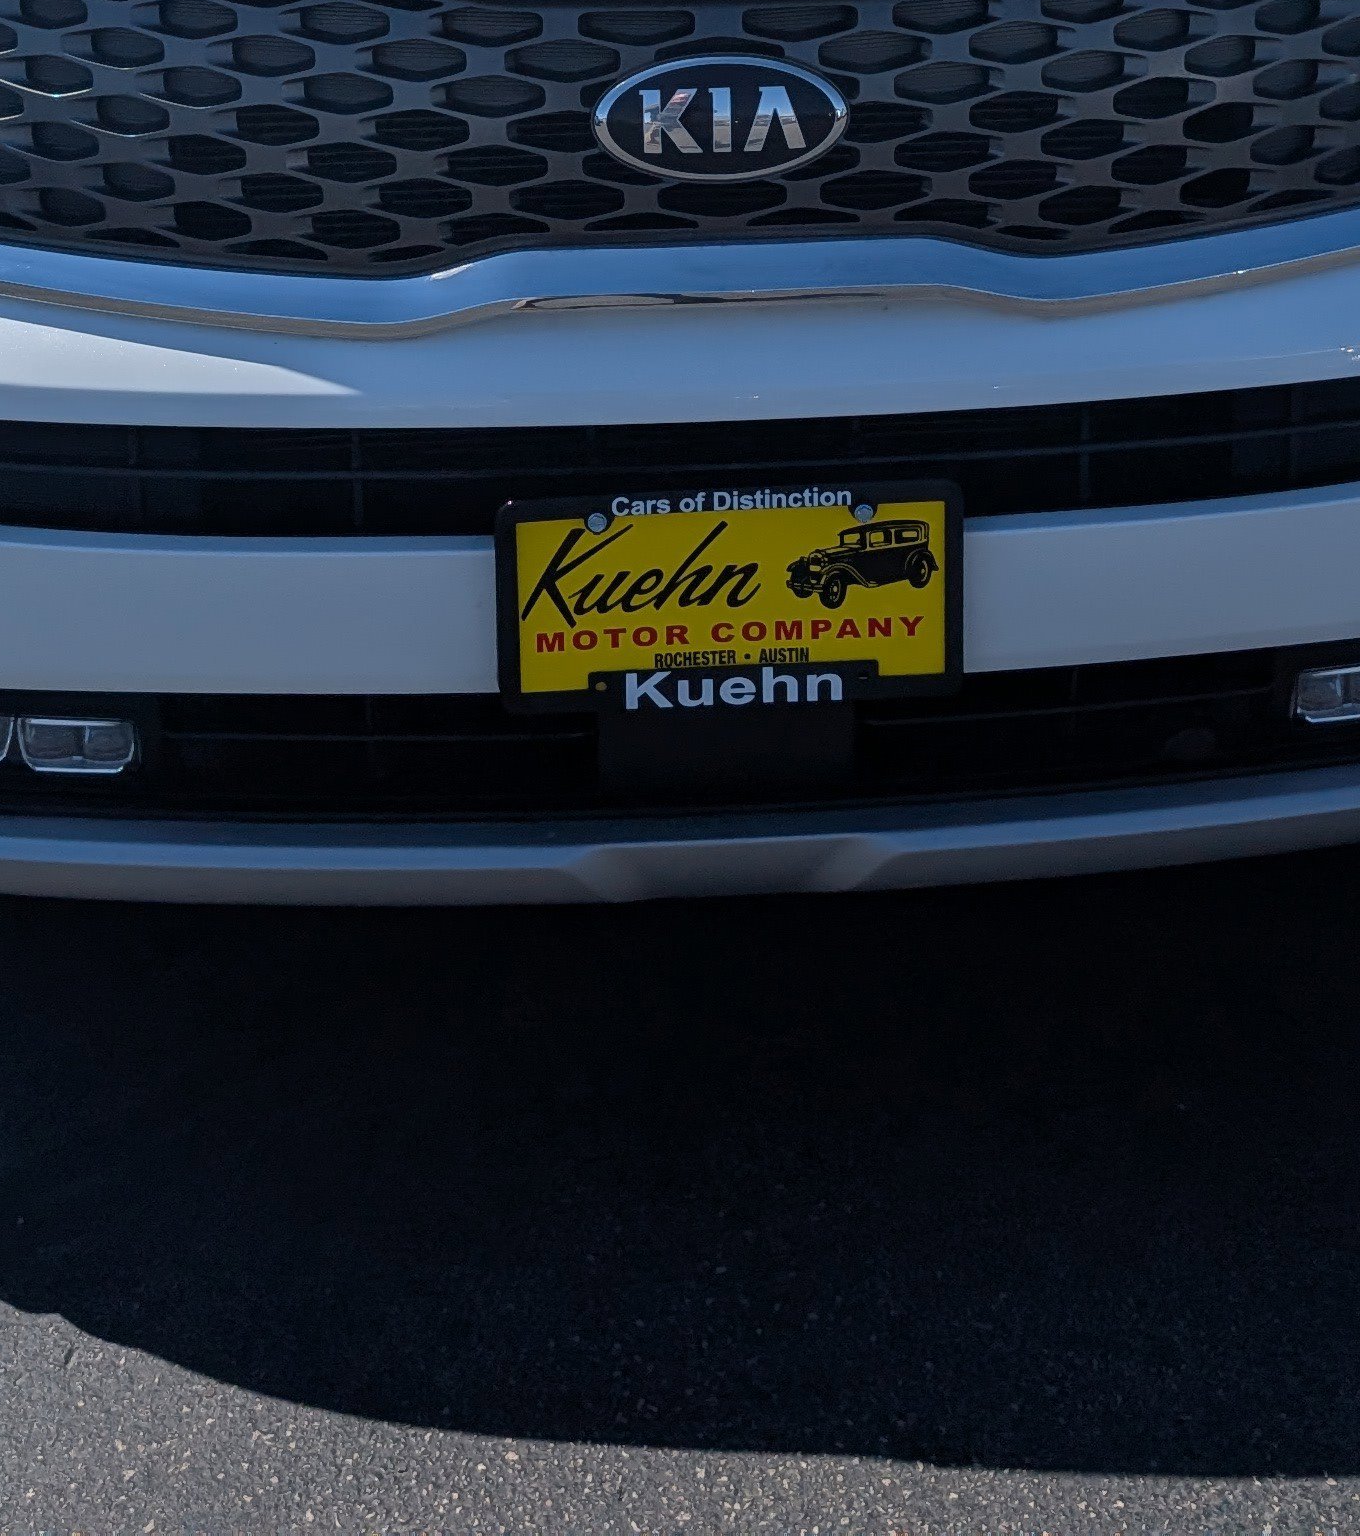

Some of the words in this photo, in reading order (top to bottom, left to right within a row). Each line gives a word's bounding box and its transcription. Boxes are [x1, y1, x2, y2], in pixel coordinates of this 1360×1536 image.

[639, 85, 807, 154] KIA
[611, 496, 671, 517] Cars
[679, 491, 706, 513] of
[713, 487, 852, 511] Distinction
[521, 520, 762, 629] Kuehn
[536, 624, 690, 653] MOTOR
[710, 616, 925, 644] COMPANY
[654, 649, 737, 669] ROCHESTER
[758, 647, 810, 664] AUSTIN
[624, 666, 844, 710] Kuehn
